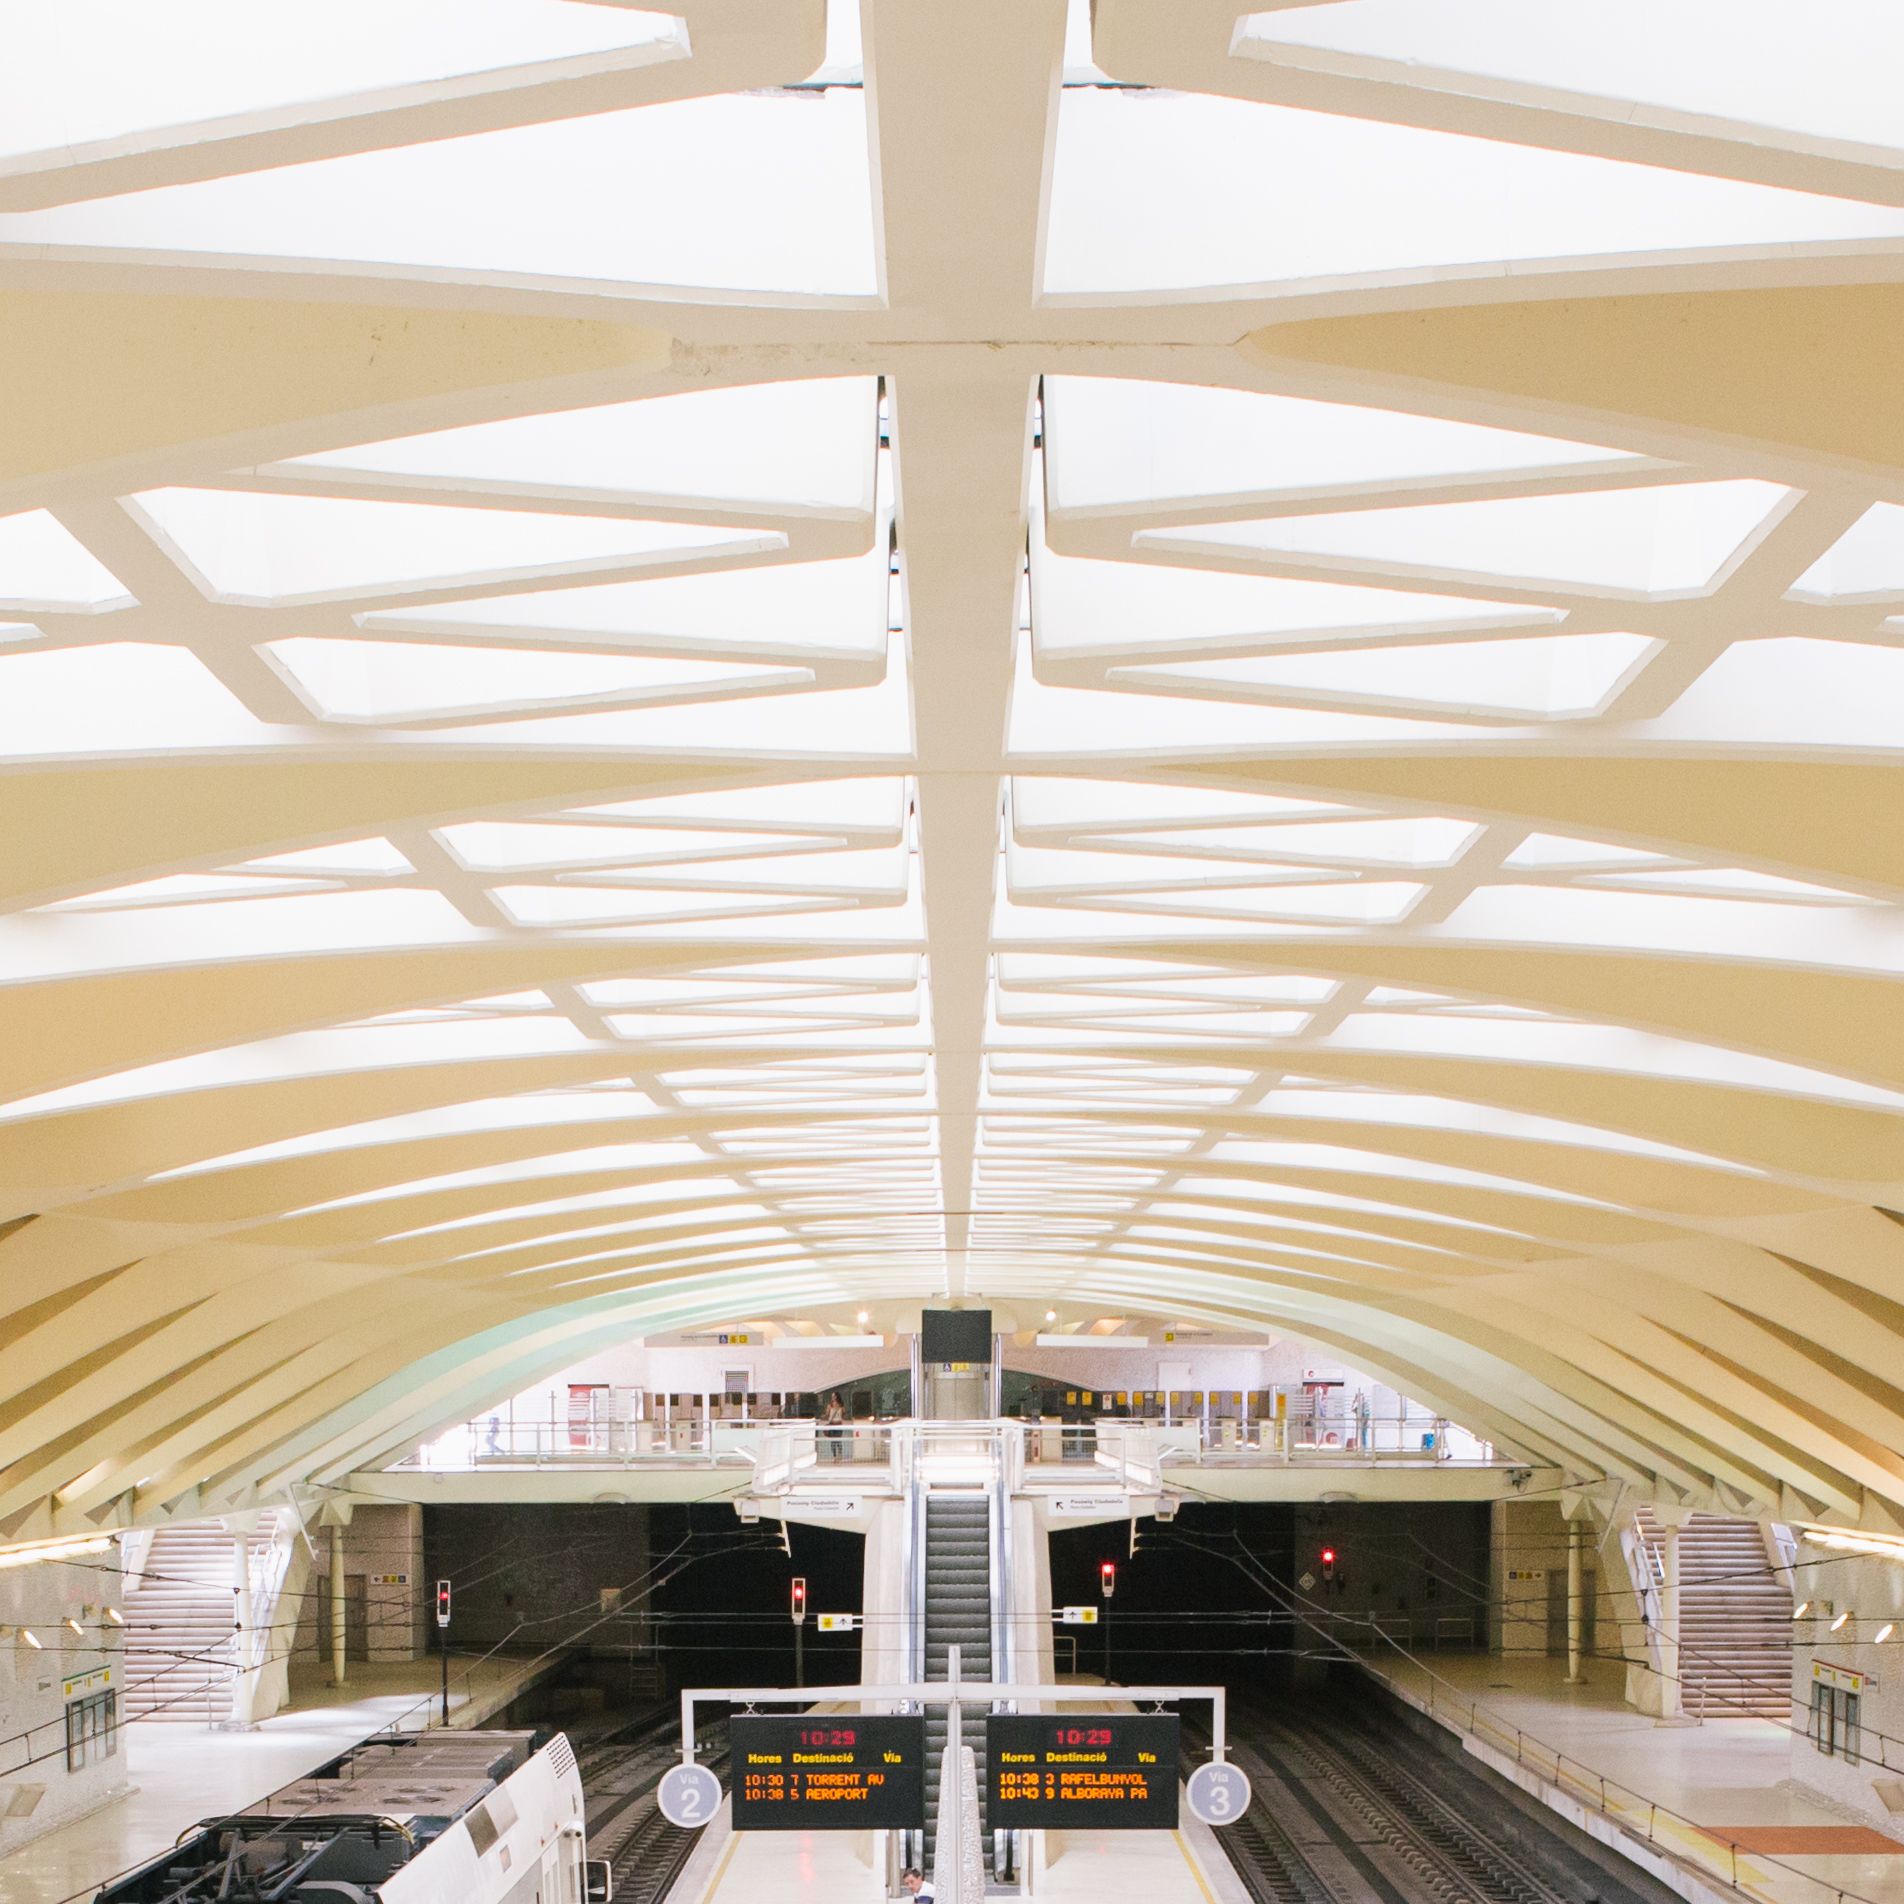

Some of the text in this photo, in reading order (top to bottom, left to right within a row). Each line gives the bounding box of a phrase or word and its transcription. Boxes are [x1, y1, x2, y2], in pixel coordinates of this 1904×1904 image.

[801, 1730, 856, 1745] 10:29
[1056, 1729, 1113, 1745] 10:29
[748, 1751, 902, 1763] Hores Destinació Via
[1001, 1751, 1156, 1763] Hores Destinació Via
[679, 1773, 699, 1784] Via
[745, 1773, 884, 1786] 10:30 7 TORRENT AV
[1046, 1773, 1055, 1785] 3
[1060, 1773, 1148, 1785] RAFELBUNYOL
[1208, 1771, 1229, 1782] Via
[790, 1788, 799, 1800] 5
[805, 1788, 869, 1800] AEROPORT
[1000, 1787, 1148, 1800] 10:43 9 ALBORAYA PA
[681, 1788, 701, 1818] 2
[1209, 1786, 1231, 1816] 3
